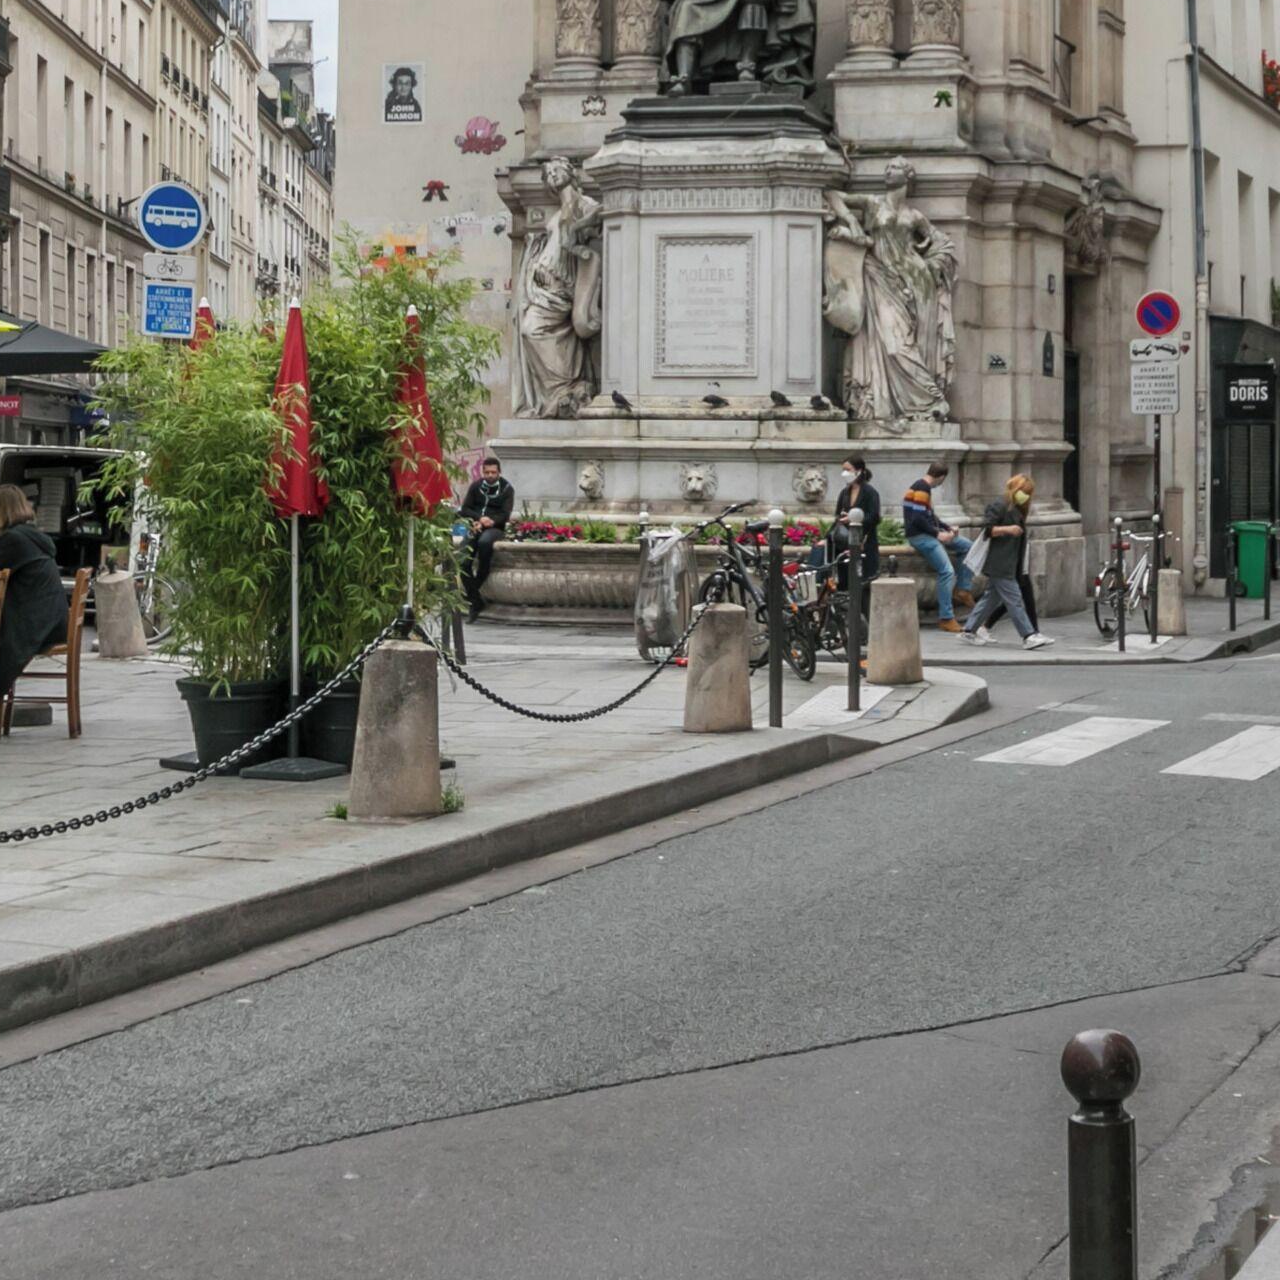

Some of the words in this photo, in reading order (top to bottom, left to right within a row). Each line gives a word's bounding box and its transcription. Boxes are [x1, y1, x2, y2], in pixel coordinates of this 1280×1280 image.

[391, 104, 415, 113] JOHN
[386, 112, 420, 121] HAMON
[1230, 386, 1269, 401] DORIS
